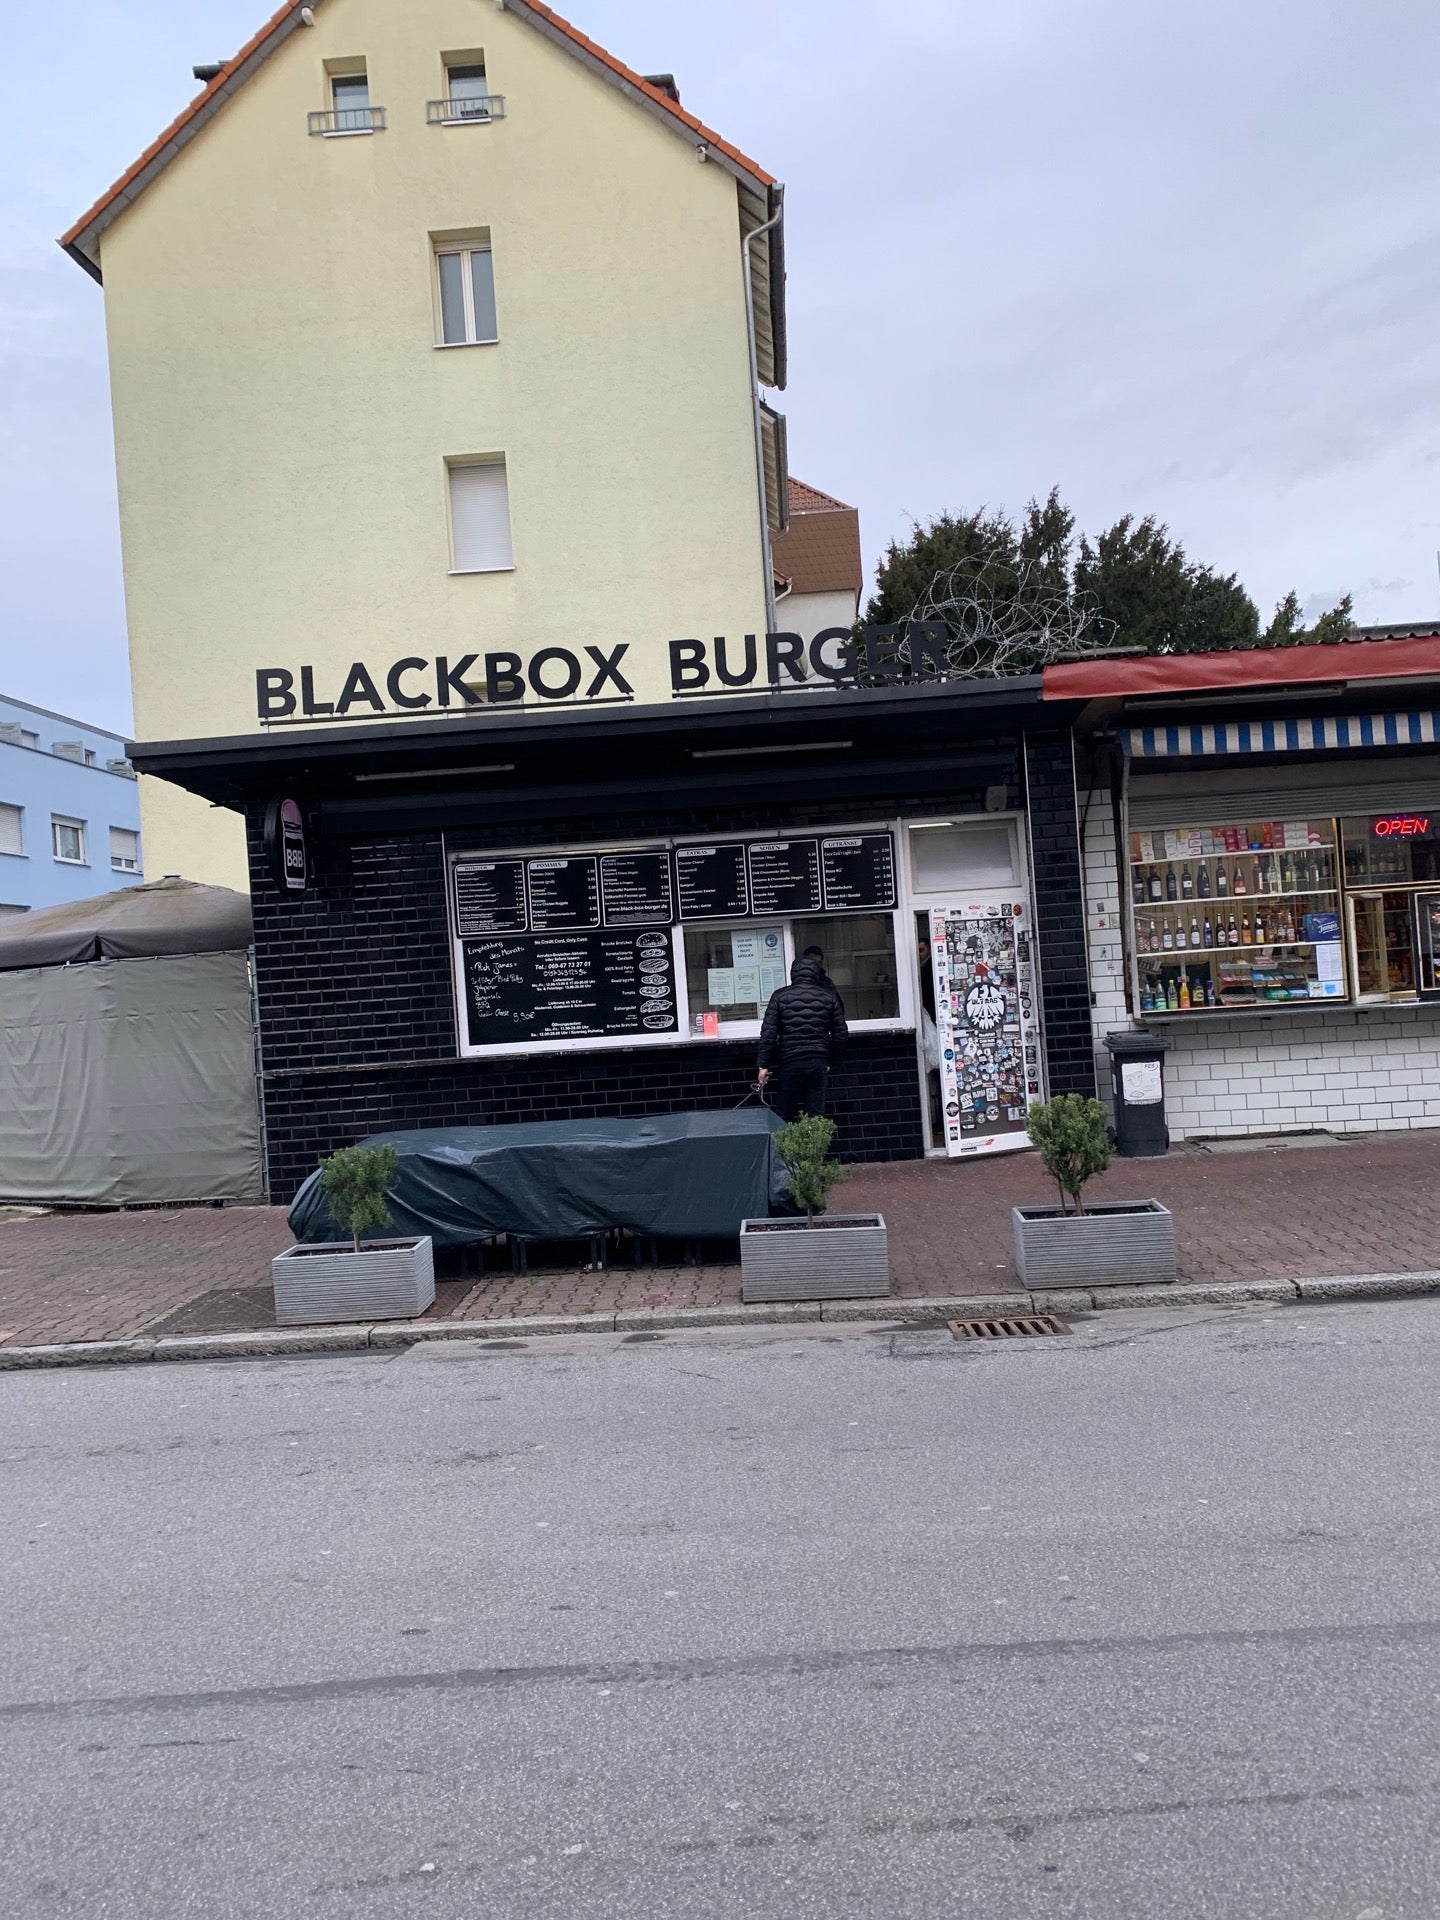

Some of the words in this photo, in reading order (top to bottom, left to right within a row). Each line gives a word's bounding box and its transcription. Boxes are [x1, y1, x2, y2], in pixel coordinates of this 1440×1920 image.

[256, 643, 634, 718] BLACKBOX
[668, 621, 951, 690] BURGER
[1375, 818, 1428, 836] OPEN
[1318, 923, 1338, 934] Tempo
